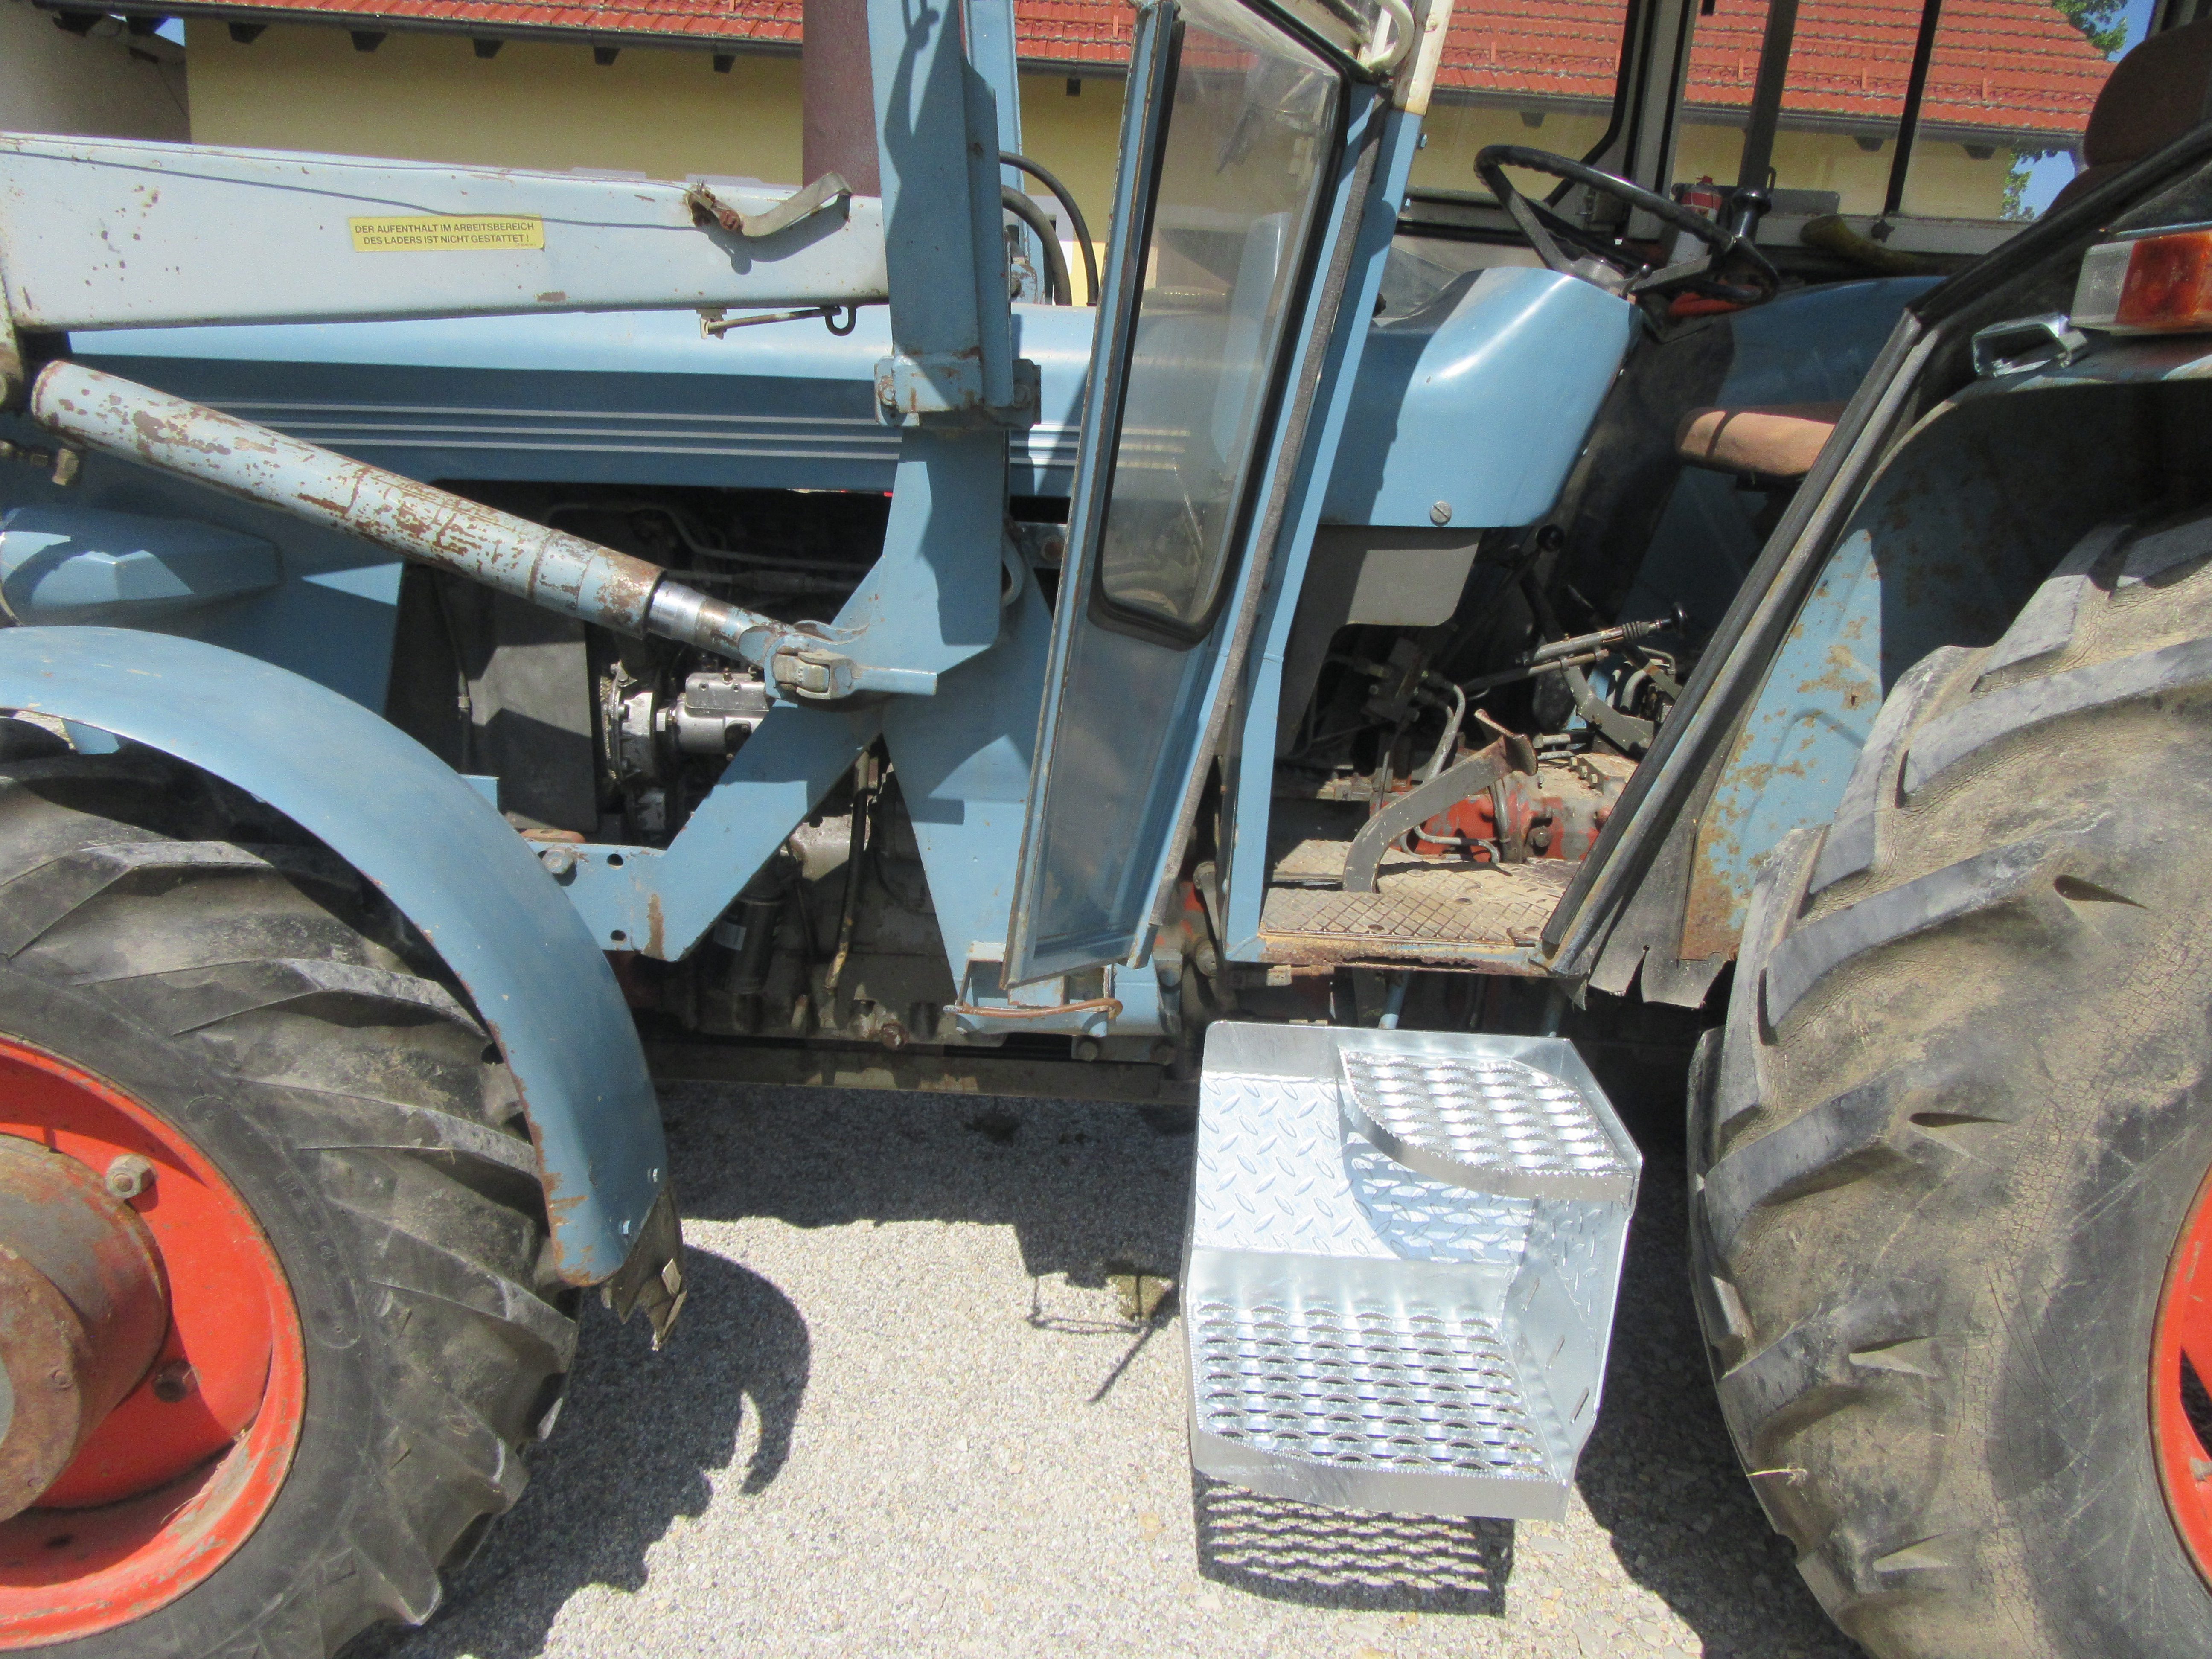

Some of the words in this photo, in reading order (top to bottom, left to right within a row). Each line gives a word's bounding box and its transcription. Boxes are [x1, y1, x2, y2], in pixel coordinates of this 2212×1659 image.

[378, 224, 438, 233] AUFENTHALT
[454, 223, 534, 231] ARBEITSBEREICH
[364, 236, 382, 244] DES
[385, 236, 422, 244] LADERS
[441, 235, 469, 243] NICHT
[471, 234, 524, 243] GESTATTET
